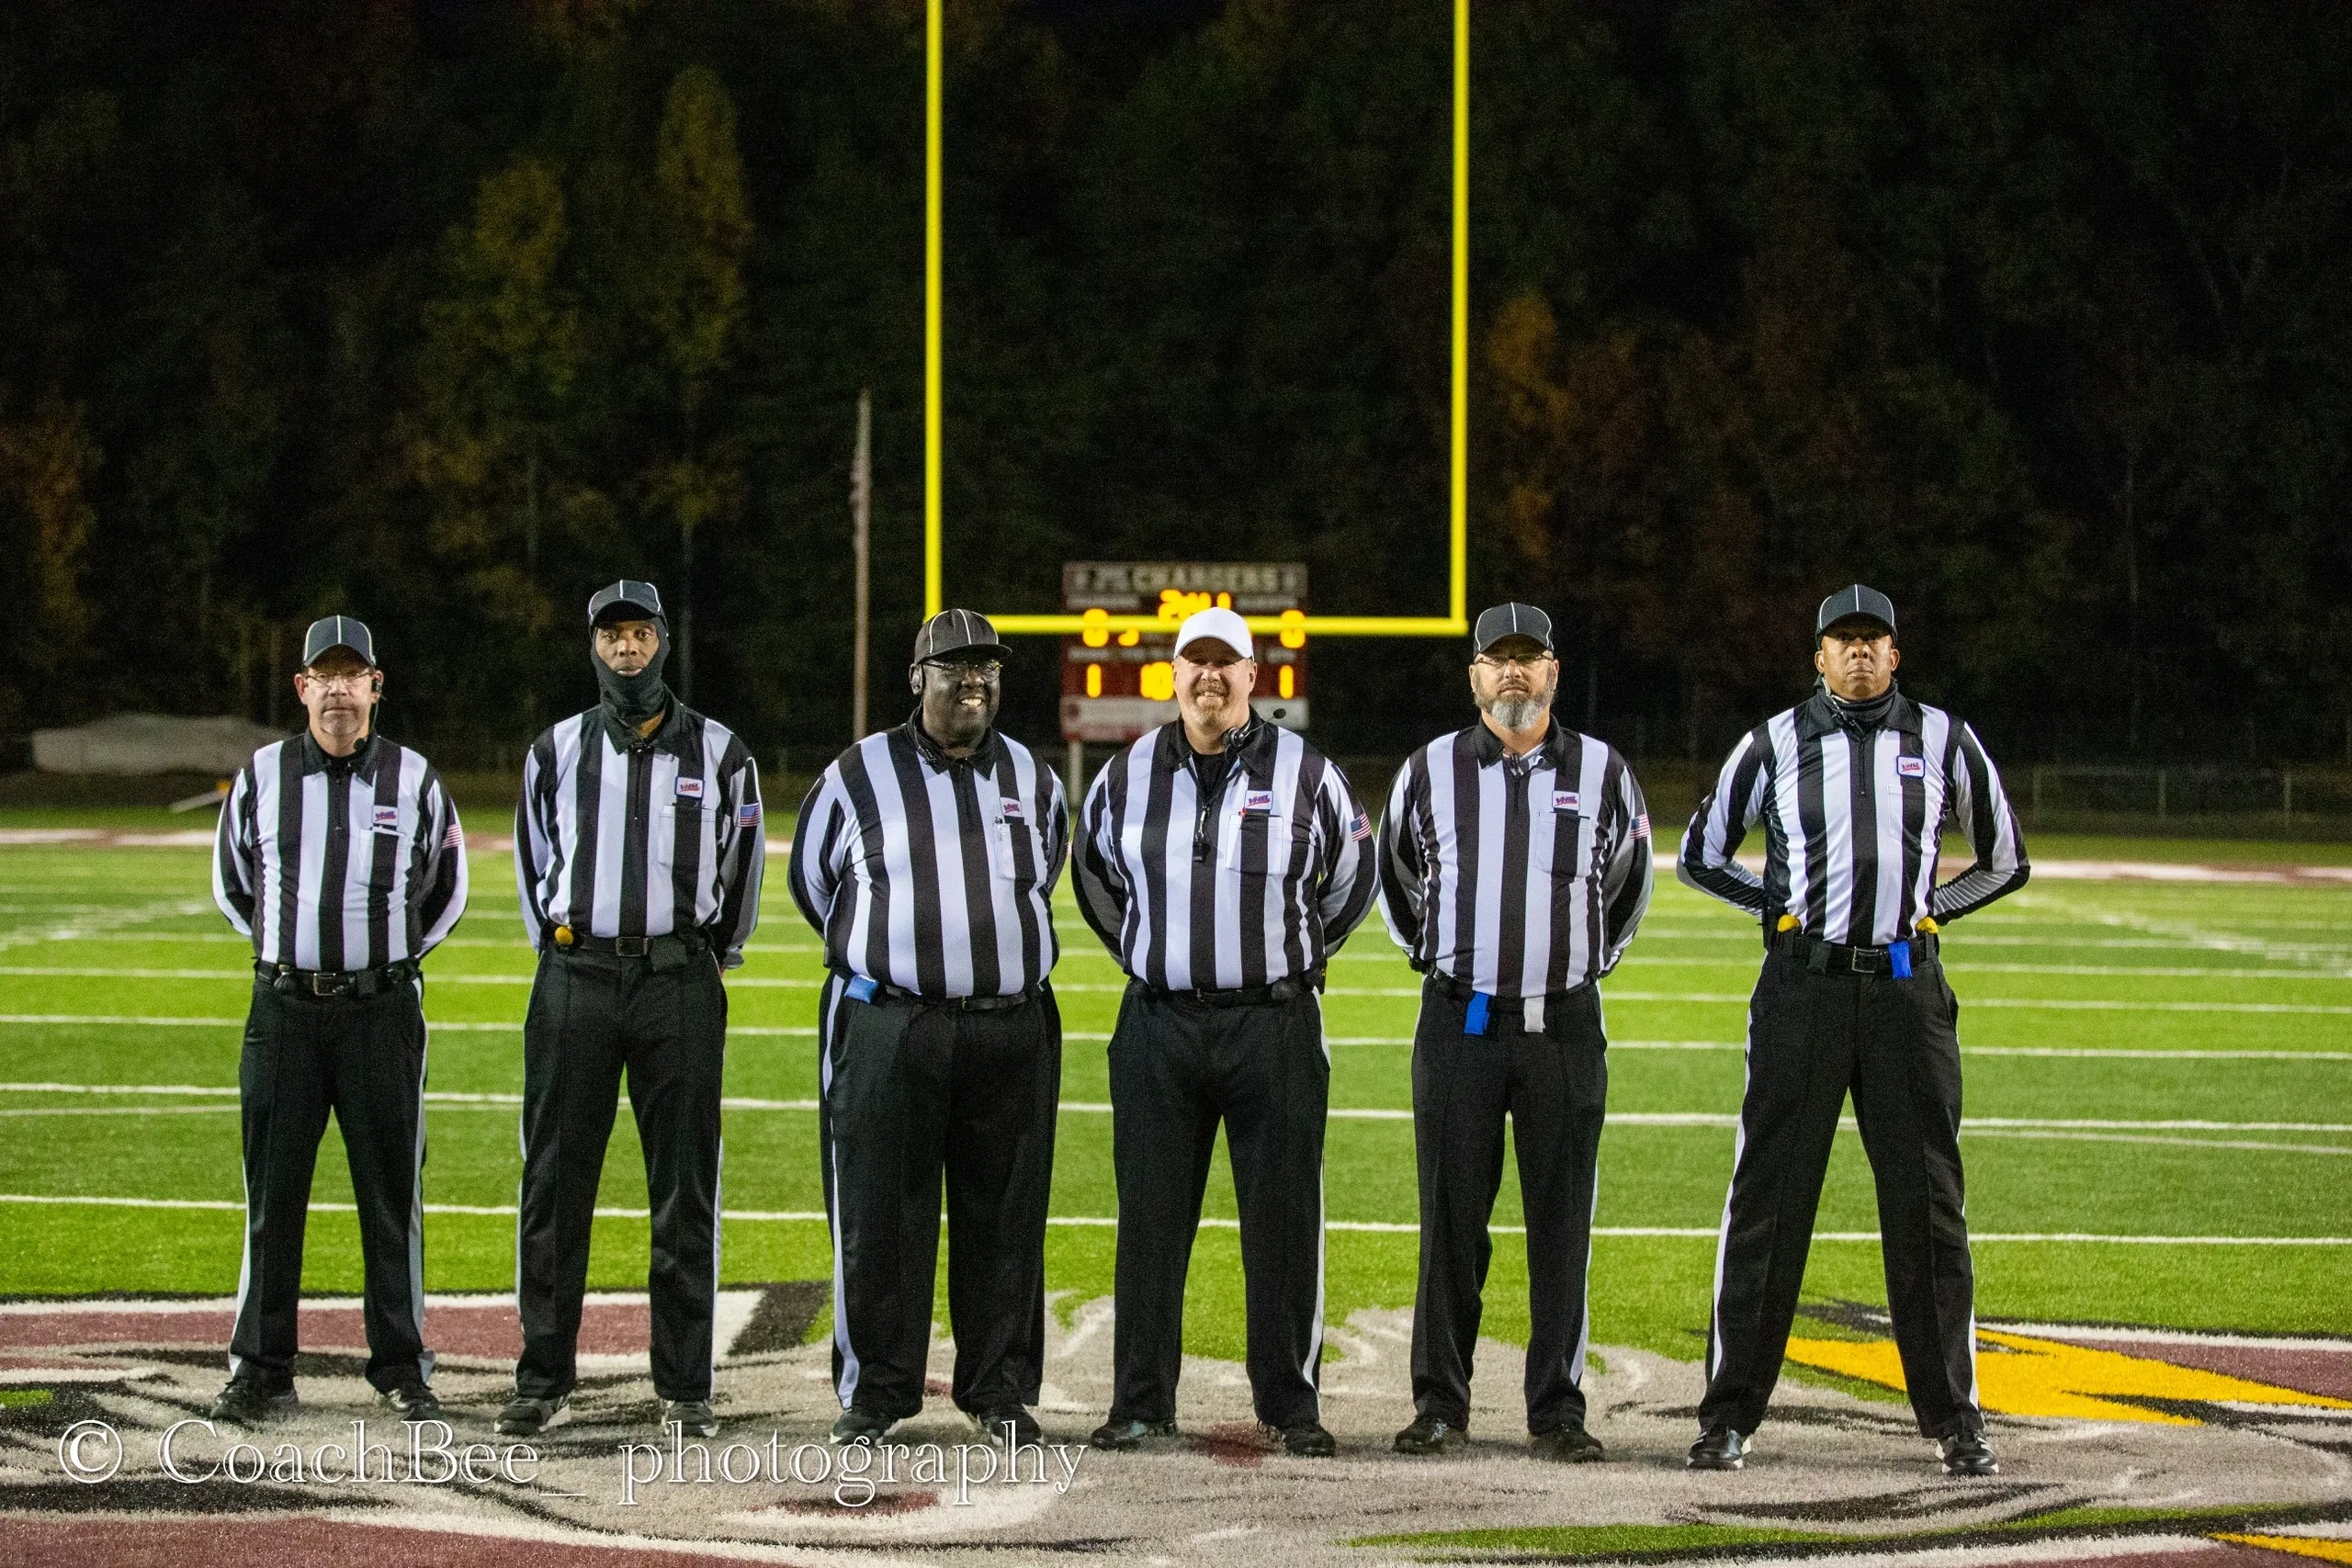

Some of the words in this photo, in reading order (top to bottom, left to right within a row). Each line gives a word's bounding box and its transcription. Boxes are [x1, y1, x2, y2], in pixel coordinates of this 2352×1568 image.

[1902, 762, 1919, 771] VHSL
[680, 783, 699, 791] VHSL
[1249, 795, 1269, 805] VHSL
[1555, 795, 1576, 805] VHSL
